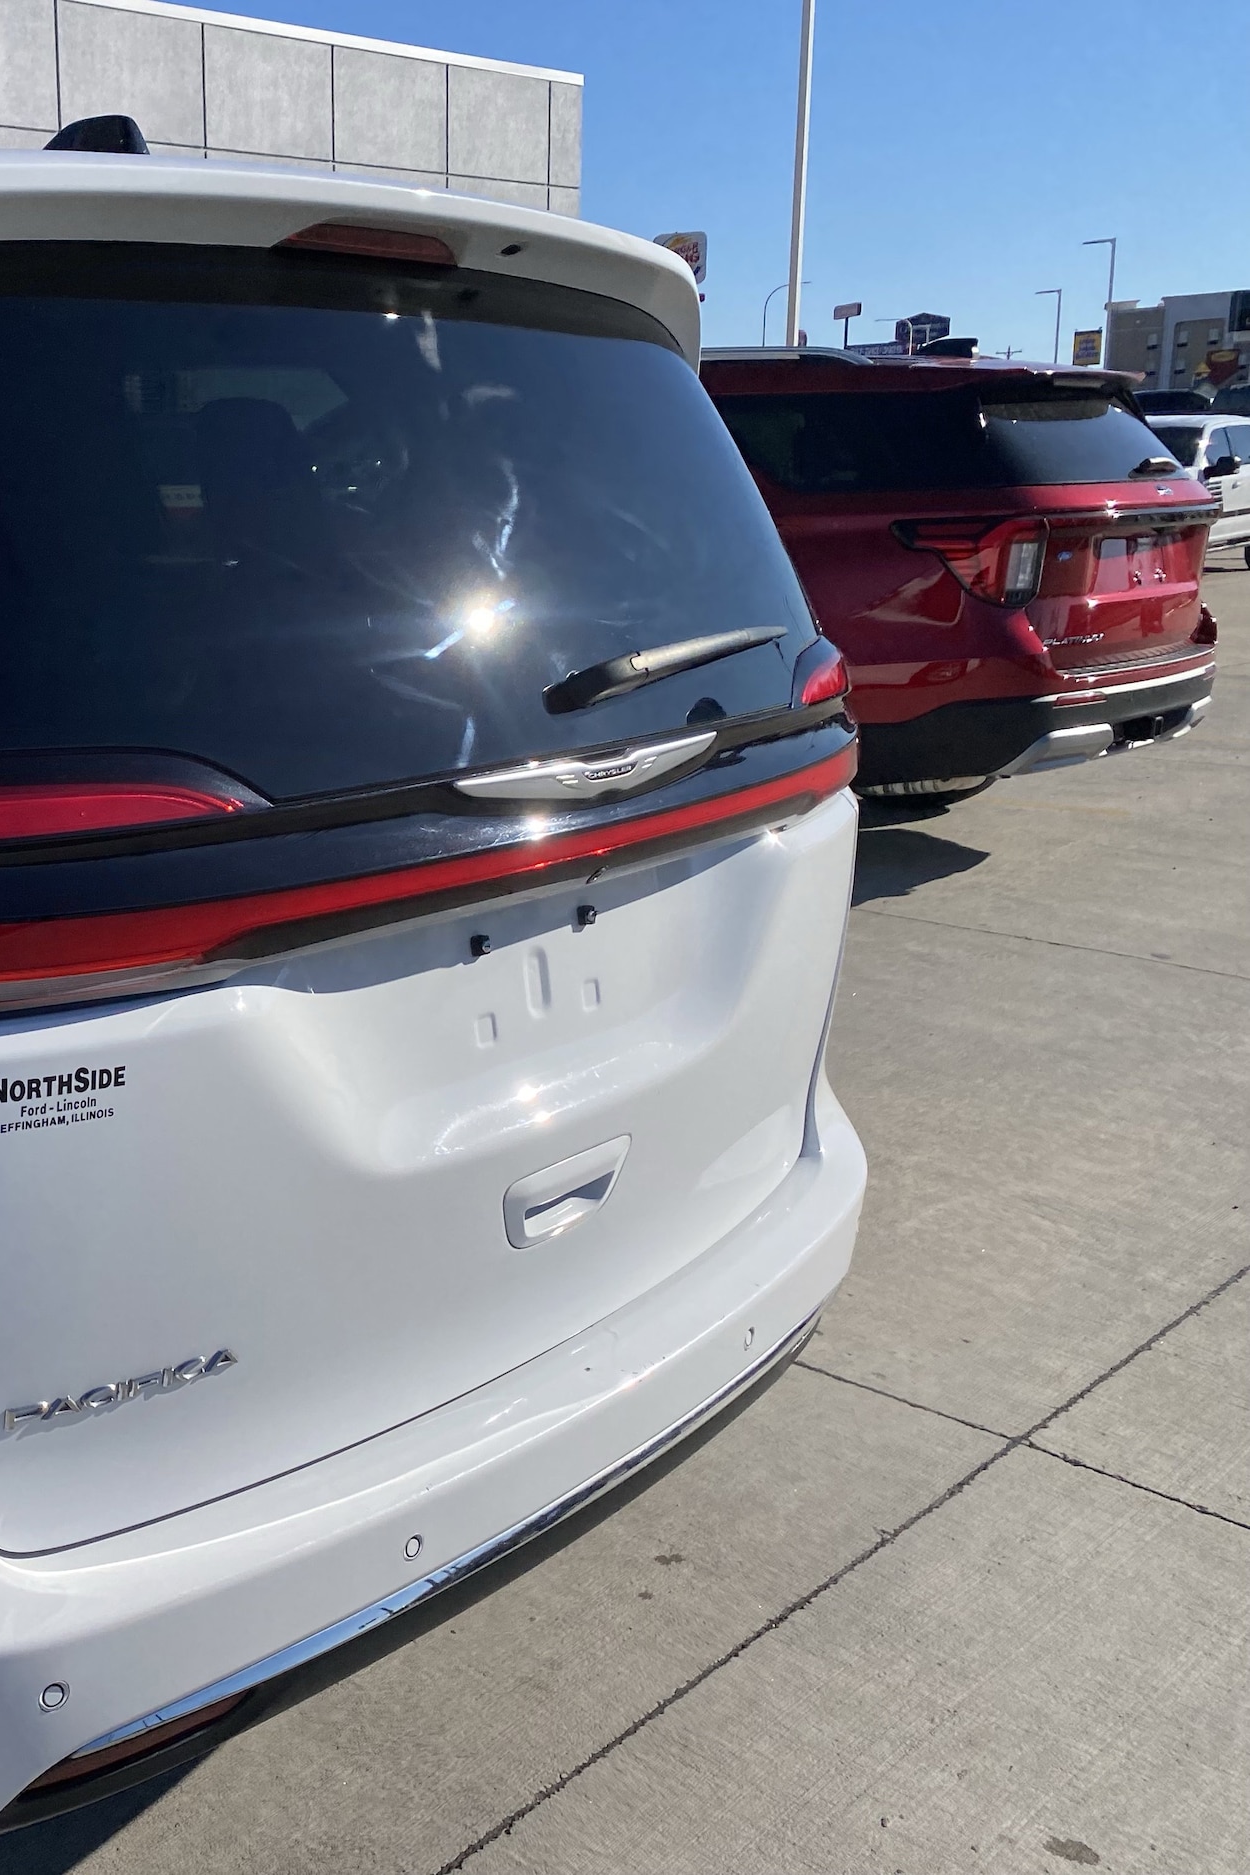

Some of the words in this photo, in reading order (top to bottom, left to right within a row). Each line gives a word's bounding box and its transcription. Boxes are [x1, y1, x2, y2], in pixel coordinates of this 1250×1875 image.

[589, 765, 632, 779] CHRYSLER
[20, 1103, 47, 1118] Ford
[56, 1096, 97, 1113] Lincoln
[0, 1115, 69, 1134] EFFINGHAM,
[71, 1107, 114, 1123] ILLINOIS
[3, 1348, 238, 1431] PACIFICA
